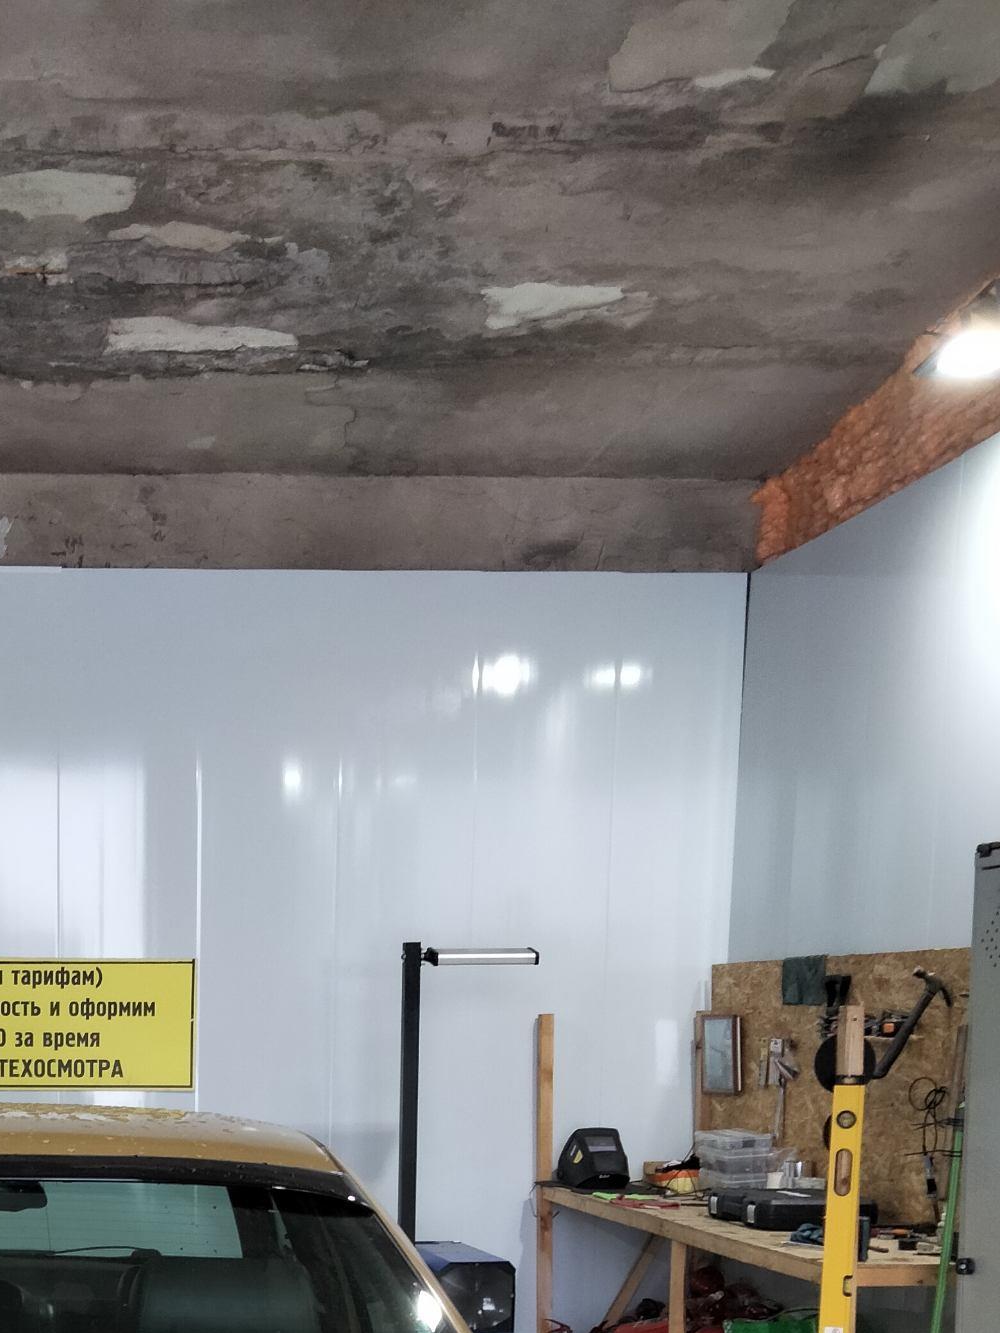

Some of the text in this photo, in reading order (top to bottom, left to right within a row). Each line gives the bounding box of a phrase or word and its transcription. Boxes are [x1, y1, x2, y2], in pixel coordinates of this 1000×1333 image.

[11, 966, 104, 988] тарифам)
[49, 1002, 61, 1017] и
[68, 997, 156, 1021] оформим
[14, 1031, 34, 1048] за
[42, 1031, 100, 1051] время
